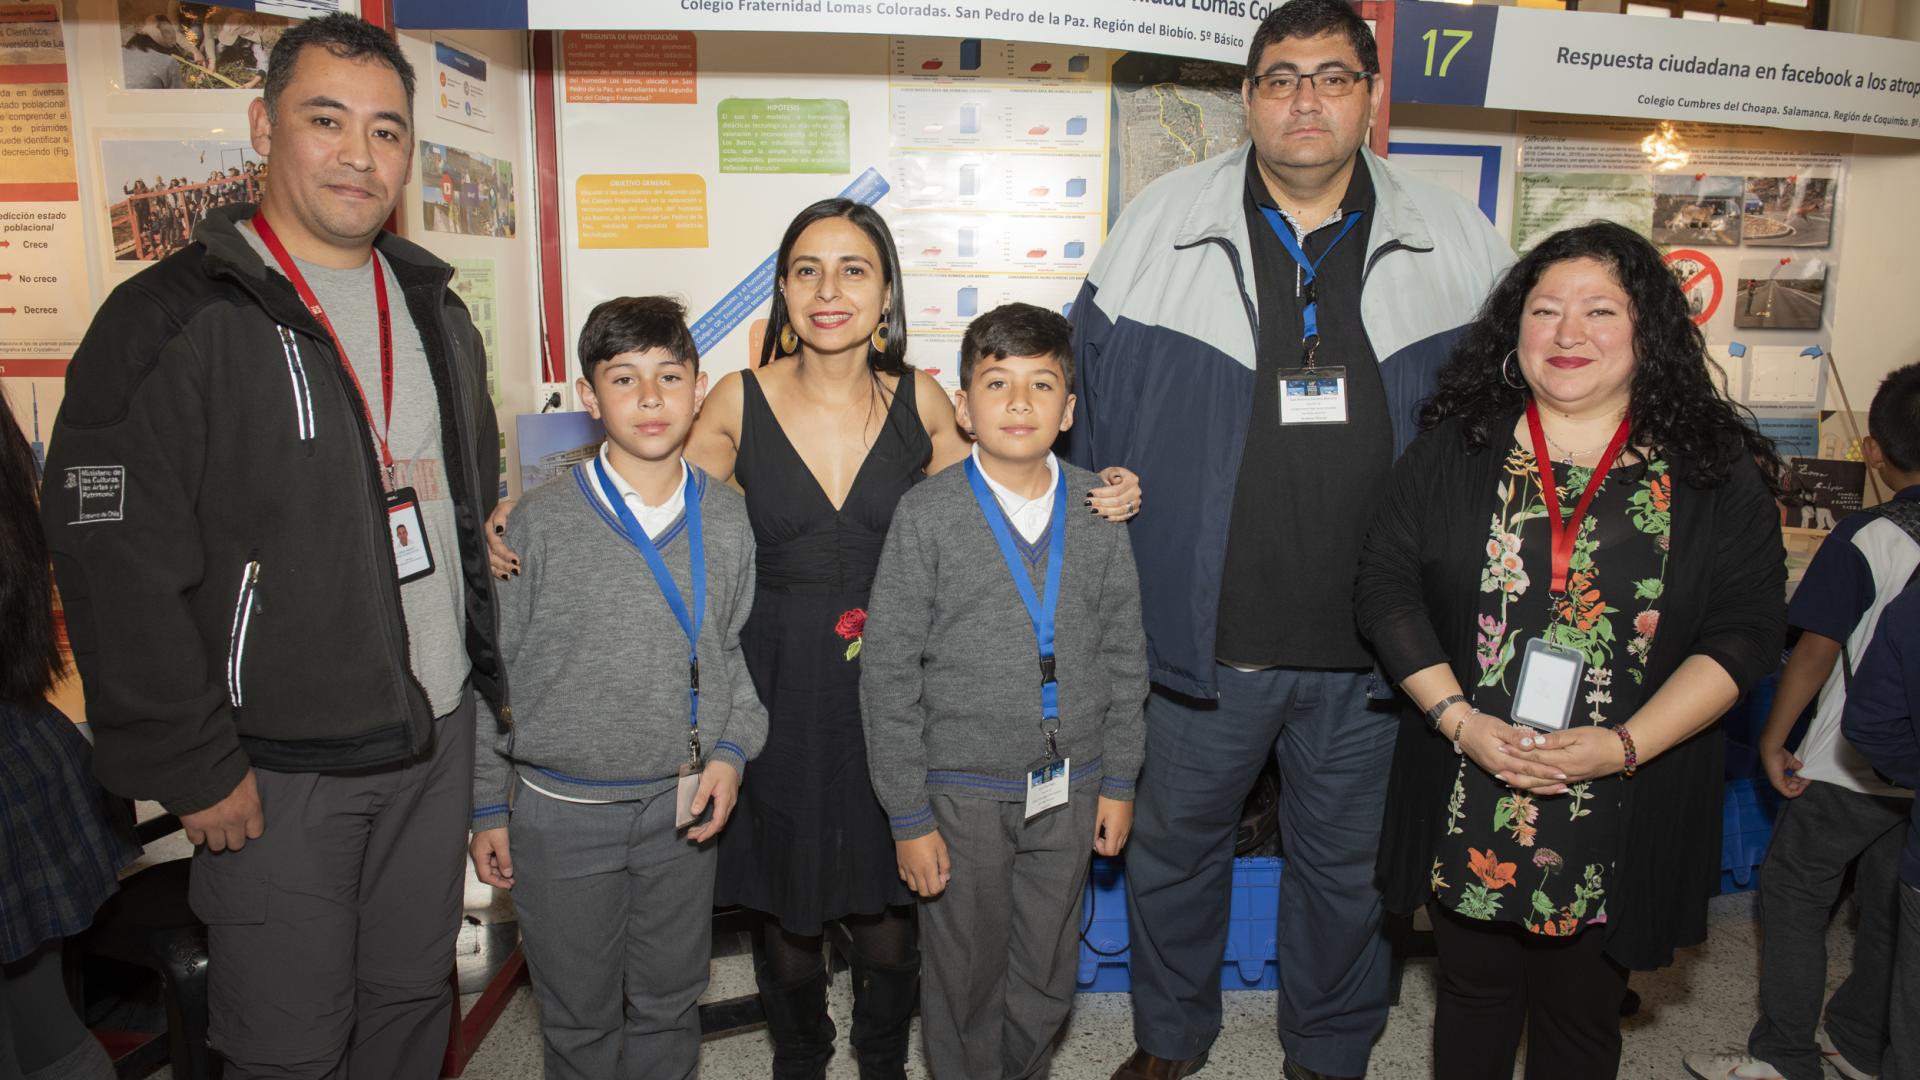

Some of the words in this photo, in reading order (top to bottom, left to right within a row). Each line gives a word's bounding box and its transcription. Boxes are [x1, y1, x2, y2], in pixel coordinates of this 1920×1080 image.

[1192, 0, 1245, 17] Lomas
[1250, 1, 1272, 21] Col
[738, 0, 822, 13] Fraternidad
[826, 1, 872, 14] Lomas
[876, 2, 951, 18] Coloradas.
[956, 6, 980, 19] San
[985, 8, 1024, 22] Pedro
[1028, 11, 1044, 24] de
[1049, 13, 1060, 25] la
[1064, 14, 1089, 28] Paz.
[1094, 19, 1134, 34] Región
[1138, 22, 1155, 35] del
[1200, 30, 1211, 41] 5º
[1214, 32, 1244, 48] Básico
[0, 40, 39, 48] niversidad
[1422, 29, 1473, 78] 17
[1556, 46, 1653, 70] Respuesta
[1658, 54, 1750, 77] ciudadana
[1756, 66, 1776, 80] en
[1781, 63, 1852, 87] facebook
[1855, 76, 1864, 88] a
[1868, 72, 1886, 91] los
[1890, 78, 1920, 98] atrop
[32, 88, 64, 96] diversas
[22, 100, 65, 110] poblacional
[1638, 94, 1675, 108] Colegio
[1678, 98, 1721, 110] Cumbres
[1724, 101, 1739, 112] del
[1742, 102, 1780, 116] Choapa.
[1783, 106, 1830, 119] Salamanca.
[1834, 110, 1860, 122] Región
[1862, 113, 1872, 122] de
[1874, 114, 1910, 127] Coquimbo.
[9, 112, 56, 122] comprender
[31, 124, 68, 133] pirámides
[2, 148, 50, 156] decreciendo
[0, 212, 35, 220] edicción
[38, 212, 66, 220] estado
[4, 224, 54, 232] poblacional
[23, 240, 48, 248] Crece
[24, 306, 58, 314] Decrece
